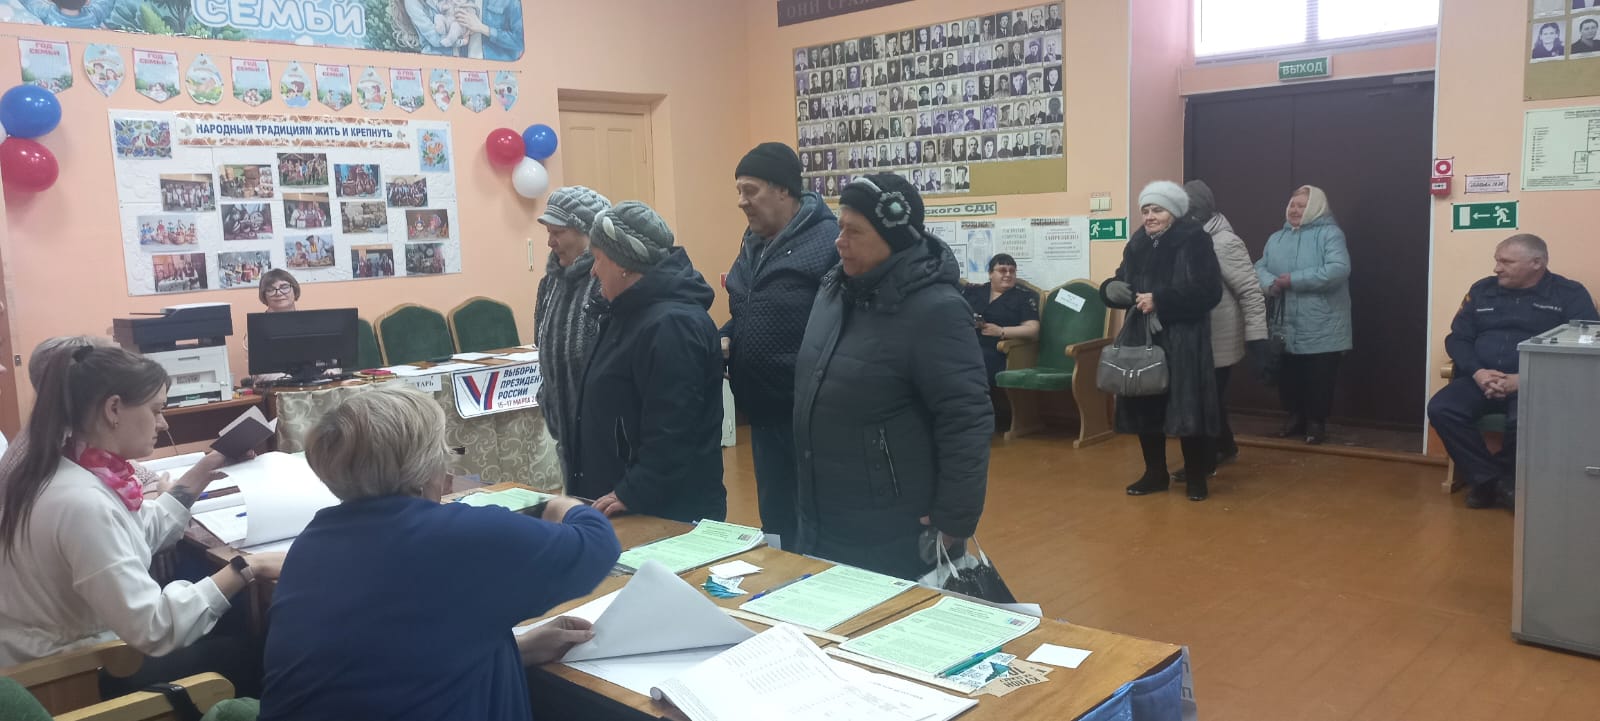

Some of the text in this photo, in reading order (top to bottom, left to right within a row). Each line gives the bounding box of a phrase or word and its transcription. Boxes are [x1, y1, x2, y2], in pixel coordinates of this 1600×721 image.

[191, 0, 366, 36] СЕМЬИ
[29, 48, 60, 56] СЕМЬИ
[35, 42, 53, 50] ГОД
[1282, 61, 1323, 75] ВЫХОД
[196, 124, 393, 138] НАРОДНЫМ ТРАДИЦИЯМ ЖИТЬ И КРЕПНУТЬ
[925, 203, 995, 215] ского СДК
[504, 365, 537, 378] ВЫБОРЫ
[500, 375, 543, 389] ПРЕЗИДЕНТ
[498, 388, 528, 400] РОССИИ
[512, 397, 531, 406] МАРТА
[1003, 677, 1041, 688] КУПОН
